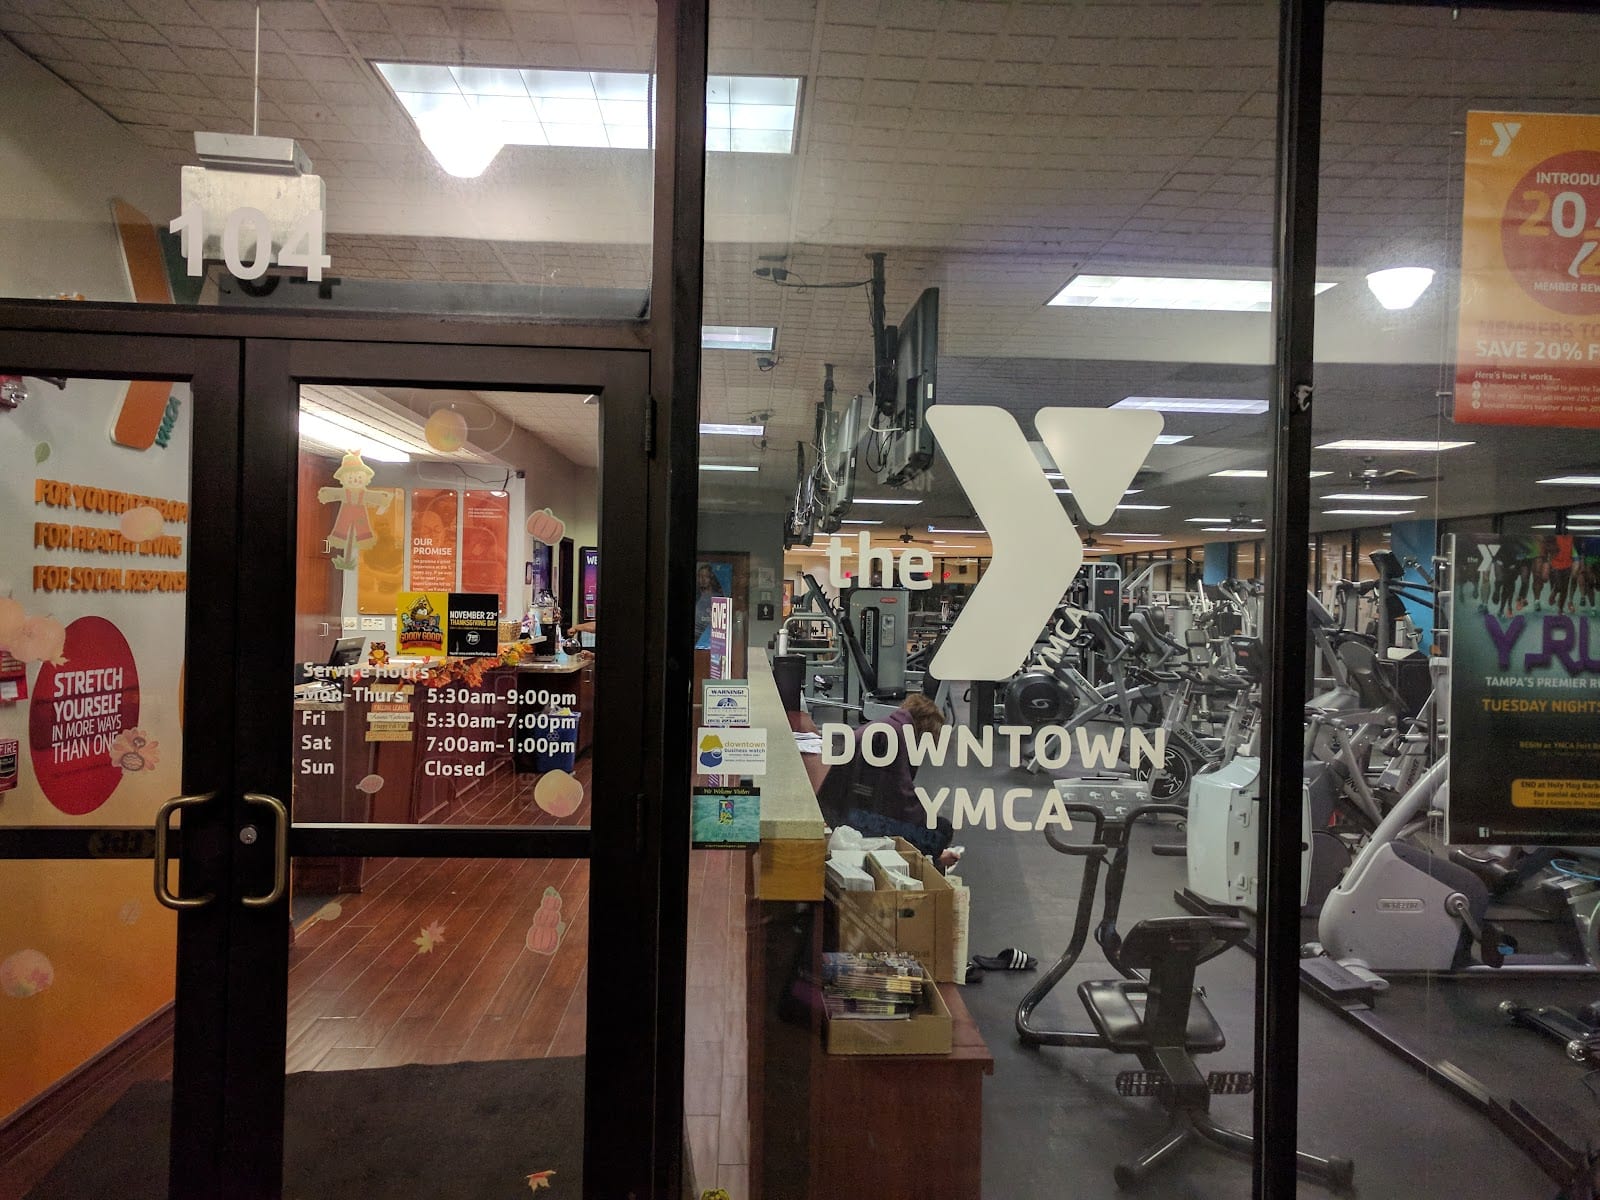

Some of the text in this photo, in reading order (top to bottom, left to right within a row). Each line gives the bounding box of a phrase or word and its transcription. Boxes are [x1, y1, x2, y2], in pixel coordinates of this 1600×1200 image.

[169, 202, 332, 282] 104
[1534, 281, 1578, 292] MEMBER
[1475, 340, 1528, 359] SAVE
[1533, 342, 1583, 361] 20%
[1502, 371, 1519, 380] how
[35, 478, 72, 509] FOR
[72, 484, 129, 515] YOUTH
[34, 521, 71, 551] FOR
[413, 537, 433, 546] OUR
[826, 405, 1165, 681] the Y
[413, 547, 452, 556] PROMISE
[33, 565, 71, 592] FOR
[71, 566, 122, 593] SOCIAL
[449, 610, 485, 619] NOVEMBER
[400, 632, 443, 642] GOODY GOODY
[1030, 607, 1090, 674] YMCA
[302, 661, 370, 679] Service
[53, 667, 123, 698] STRETCH
[1485, 676, 1534, 688] TAMPA'S
[1537, 677, 1587, 688] PREMIER
[53, 693, 122, 722] YOURSELF
[302, 687, 577, 707] Mon-Thurs 5:30am-9:00pm
[1482, 699, 1548, 712] TUESDAY
[52, 714, 122, 742] IN MORE WAYS
[302, 710, 577, 732] Fri 5:30am-7:00pm
[52, 737, 90, 764] THAN
[301, 735, 576, 757] Sat 7:00am-1:00pm
[724, 740, 765, 748] downtown
[821, 723, 1167, 769] DOWNTOWN
[301, 759, 486, 777] Sun Closed
[914, 787, 1073, 831] YMCA
